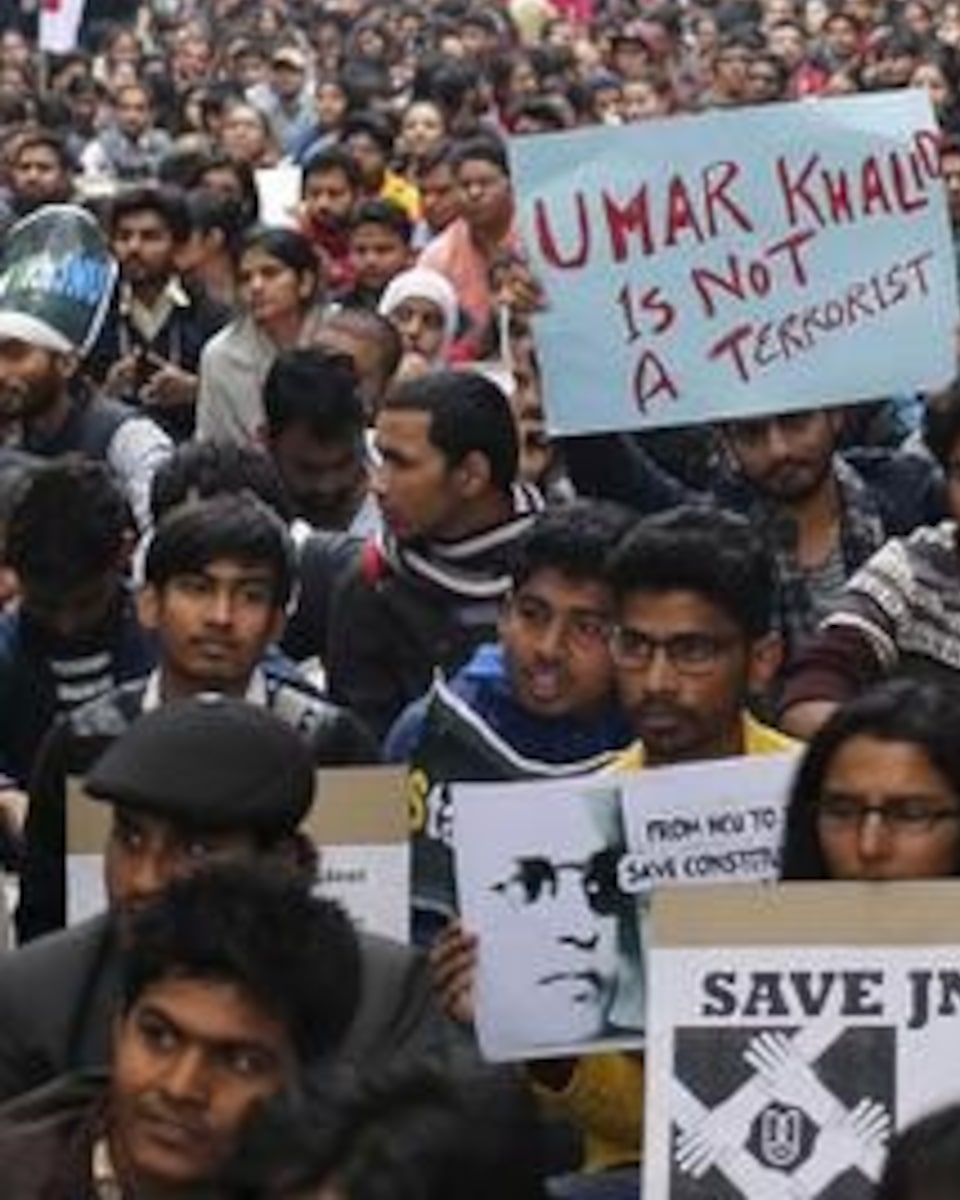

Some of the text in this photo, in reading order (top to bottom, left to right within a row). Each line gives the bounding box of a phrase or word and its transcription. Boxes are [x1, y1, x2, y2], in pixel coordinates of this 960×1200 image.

[534, 129, 945, 270] UMAR KHALID
[619, 284, 674, 343] IS
[632, 251, 934, 415] A TERRORIST
[750, 809, 777, 830] TO
[626, 856, 677, 882] SAVE
[701, 971, 884, 1018] SAVE
